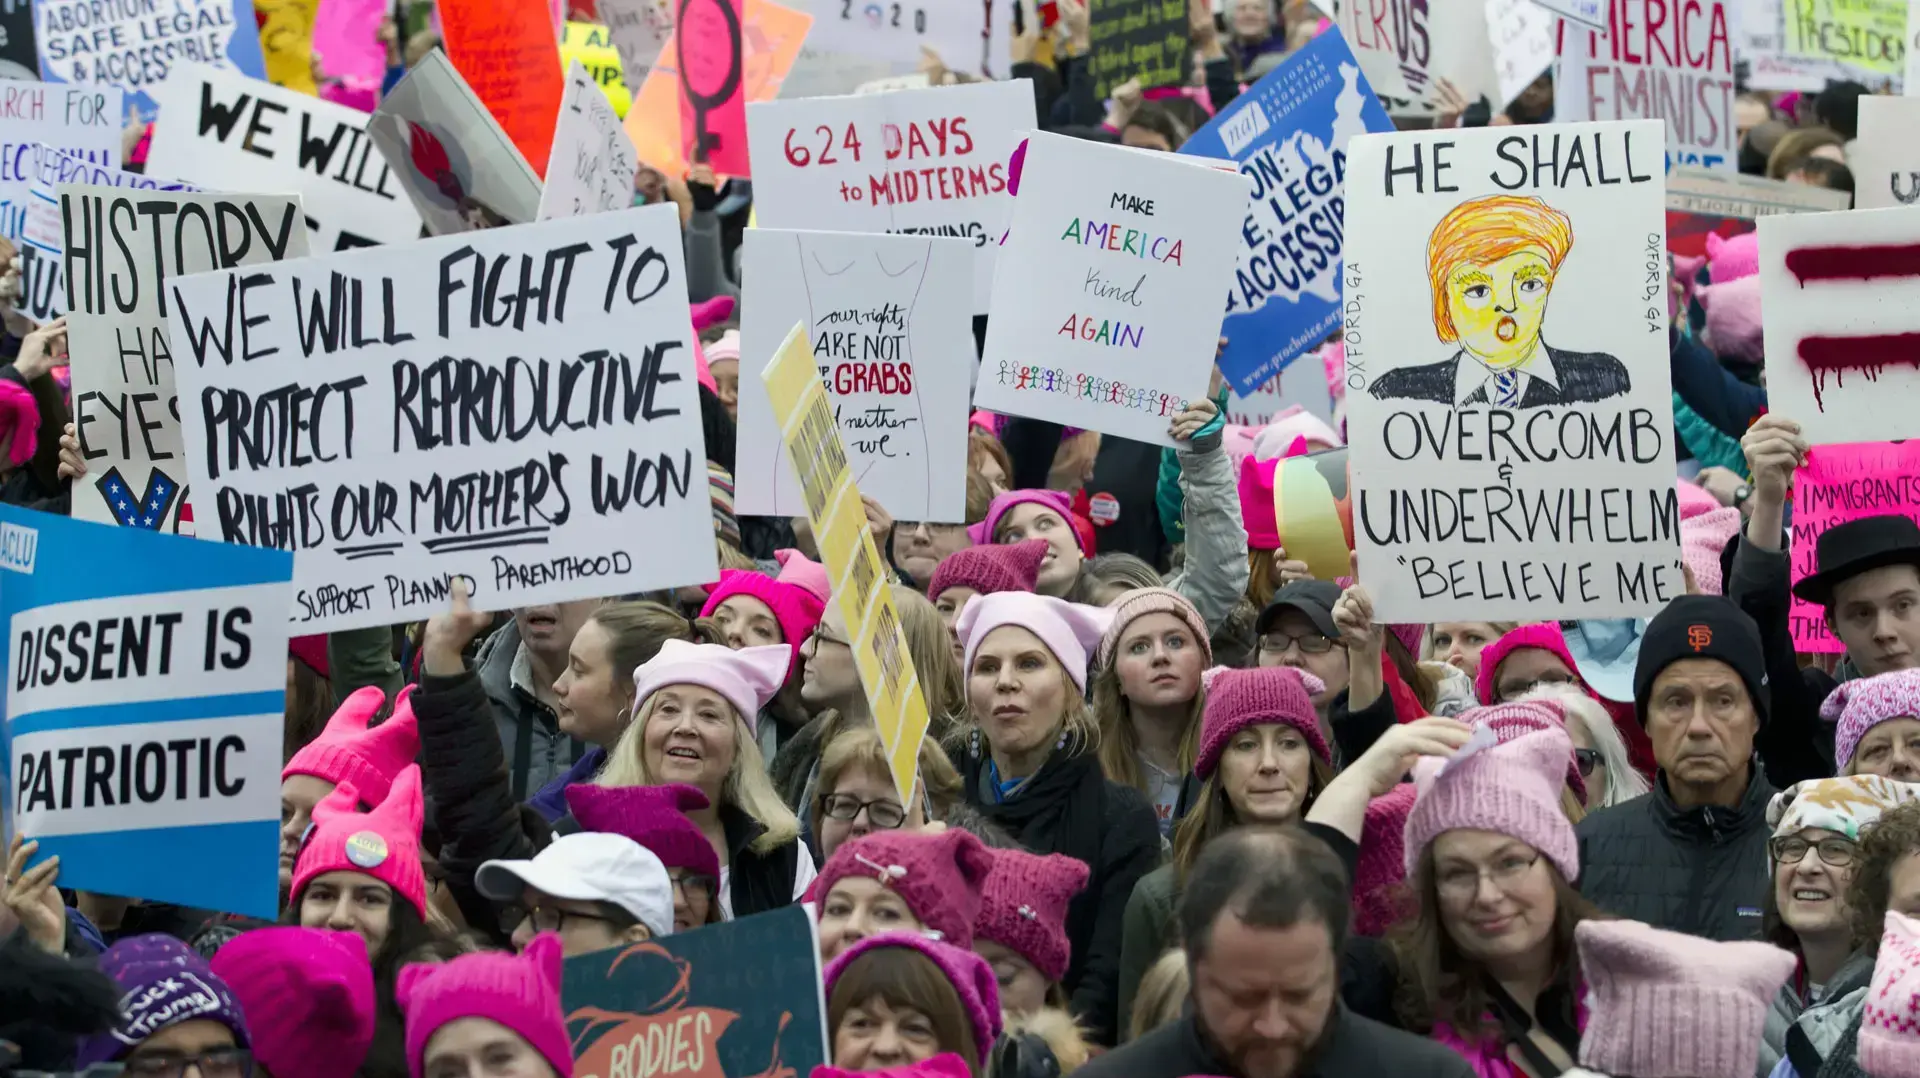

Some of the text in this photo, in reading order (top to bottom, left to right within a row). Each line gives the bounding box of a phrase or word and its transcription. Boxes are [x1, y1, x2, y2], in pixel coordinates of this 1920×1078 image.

[140, 6, 231, 40] LEGAL
[73, 61, 87, 81] &
[0, 87, 108, 126] RCH FOR
[199, 81, 396, 200] WE WILL
[785, 116, 974, 168] 624 DAYS
[1385, 131, 1652, 196] HE SHALL
[840, 163, 1006, 206] to MIDTERMS
[1111, 192, 1155, 216] MAKE
[61, 194, 296, 318] HISTORY
[1062, 218, 1184, 267] AMERICA
[173, 233, 670, 368] WE WILL FIGHT TO
[816, 303, 907, 334] our rights
[1647, 308, 1662, 333] GA
[814, 332, 906, 361] ARE NOT
[1058, 313, 1145, 349] AGAIN
[1345, 262, 1367, 391] OXFORD, GA
[835, 363, 912, 395] GRABS
[201, 341, 683, 479] PROTECT REPRODUCTIVE
[845, 404, 917, 430] neither
[1383, 408, 1662, 463] OVERCOMB
[1497, 455, 1514, 488] &
[216, 482, 325, 551] RIGHTS
[331, 480, 405, 540] OUR
[591, 449, 692, 516] WON
[1361, 486, 1681, 546] UNDERWHELM
[1, 530, 35, 568] ACLU
[384, 574, 477, 609] PLANND
[492, 551, 632, 590] PARENTHOOD
[1396, 554, 1684, 604] "BELIEVE ME"
[16, 606, 253, 693] DISSENT IS
[17, 735, 247, 815] PATRIOTIC
[610, 1011, 712, 1078] BODIES
